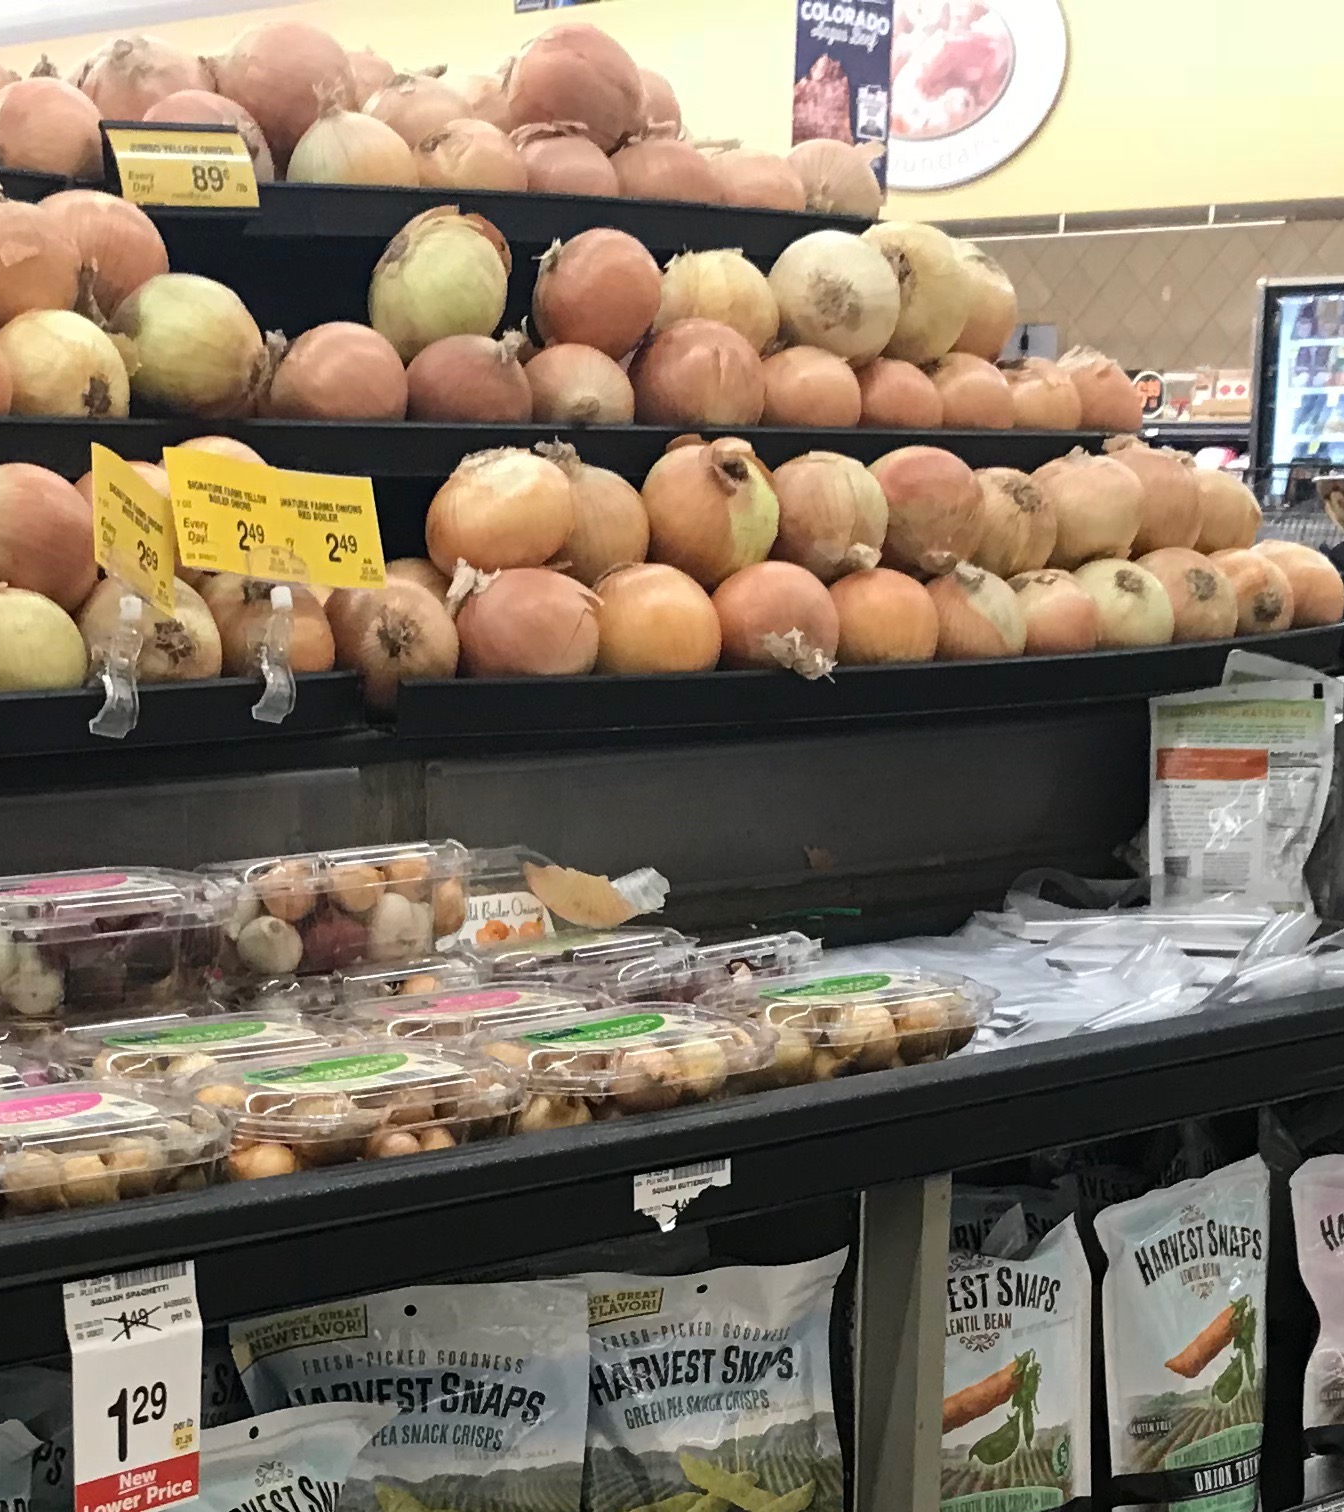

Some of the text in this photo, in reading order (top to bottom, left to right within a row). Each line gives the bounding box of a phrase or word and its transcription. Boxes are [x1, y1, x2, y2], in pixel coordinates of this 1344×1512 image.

[800, 2, 891, 37] COLORADO
[1134, 1218, 1263, 1288] HARVEST SNAPS
[996, 1265, 1061, 1314] SNAPS
[983, 1312, 1012, 1331] BEAN
[302, 1349, 525, 1376] FRESH-PICKED GOODNESS
[589, 1349, 717, 1407] HARVEST
[440, 1372, 546, 1424] SNAPS
[624, 1389, 770, 1430] GREEN CRISPS
[401, 1423, 504, 1451] SNACK CRISPS
[119, 1468, 157, 1490] New
[146, 1478, 193, 1504] Price
[1194, 1464, 1233, 1492] ONION
